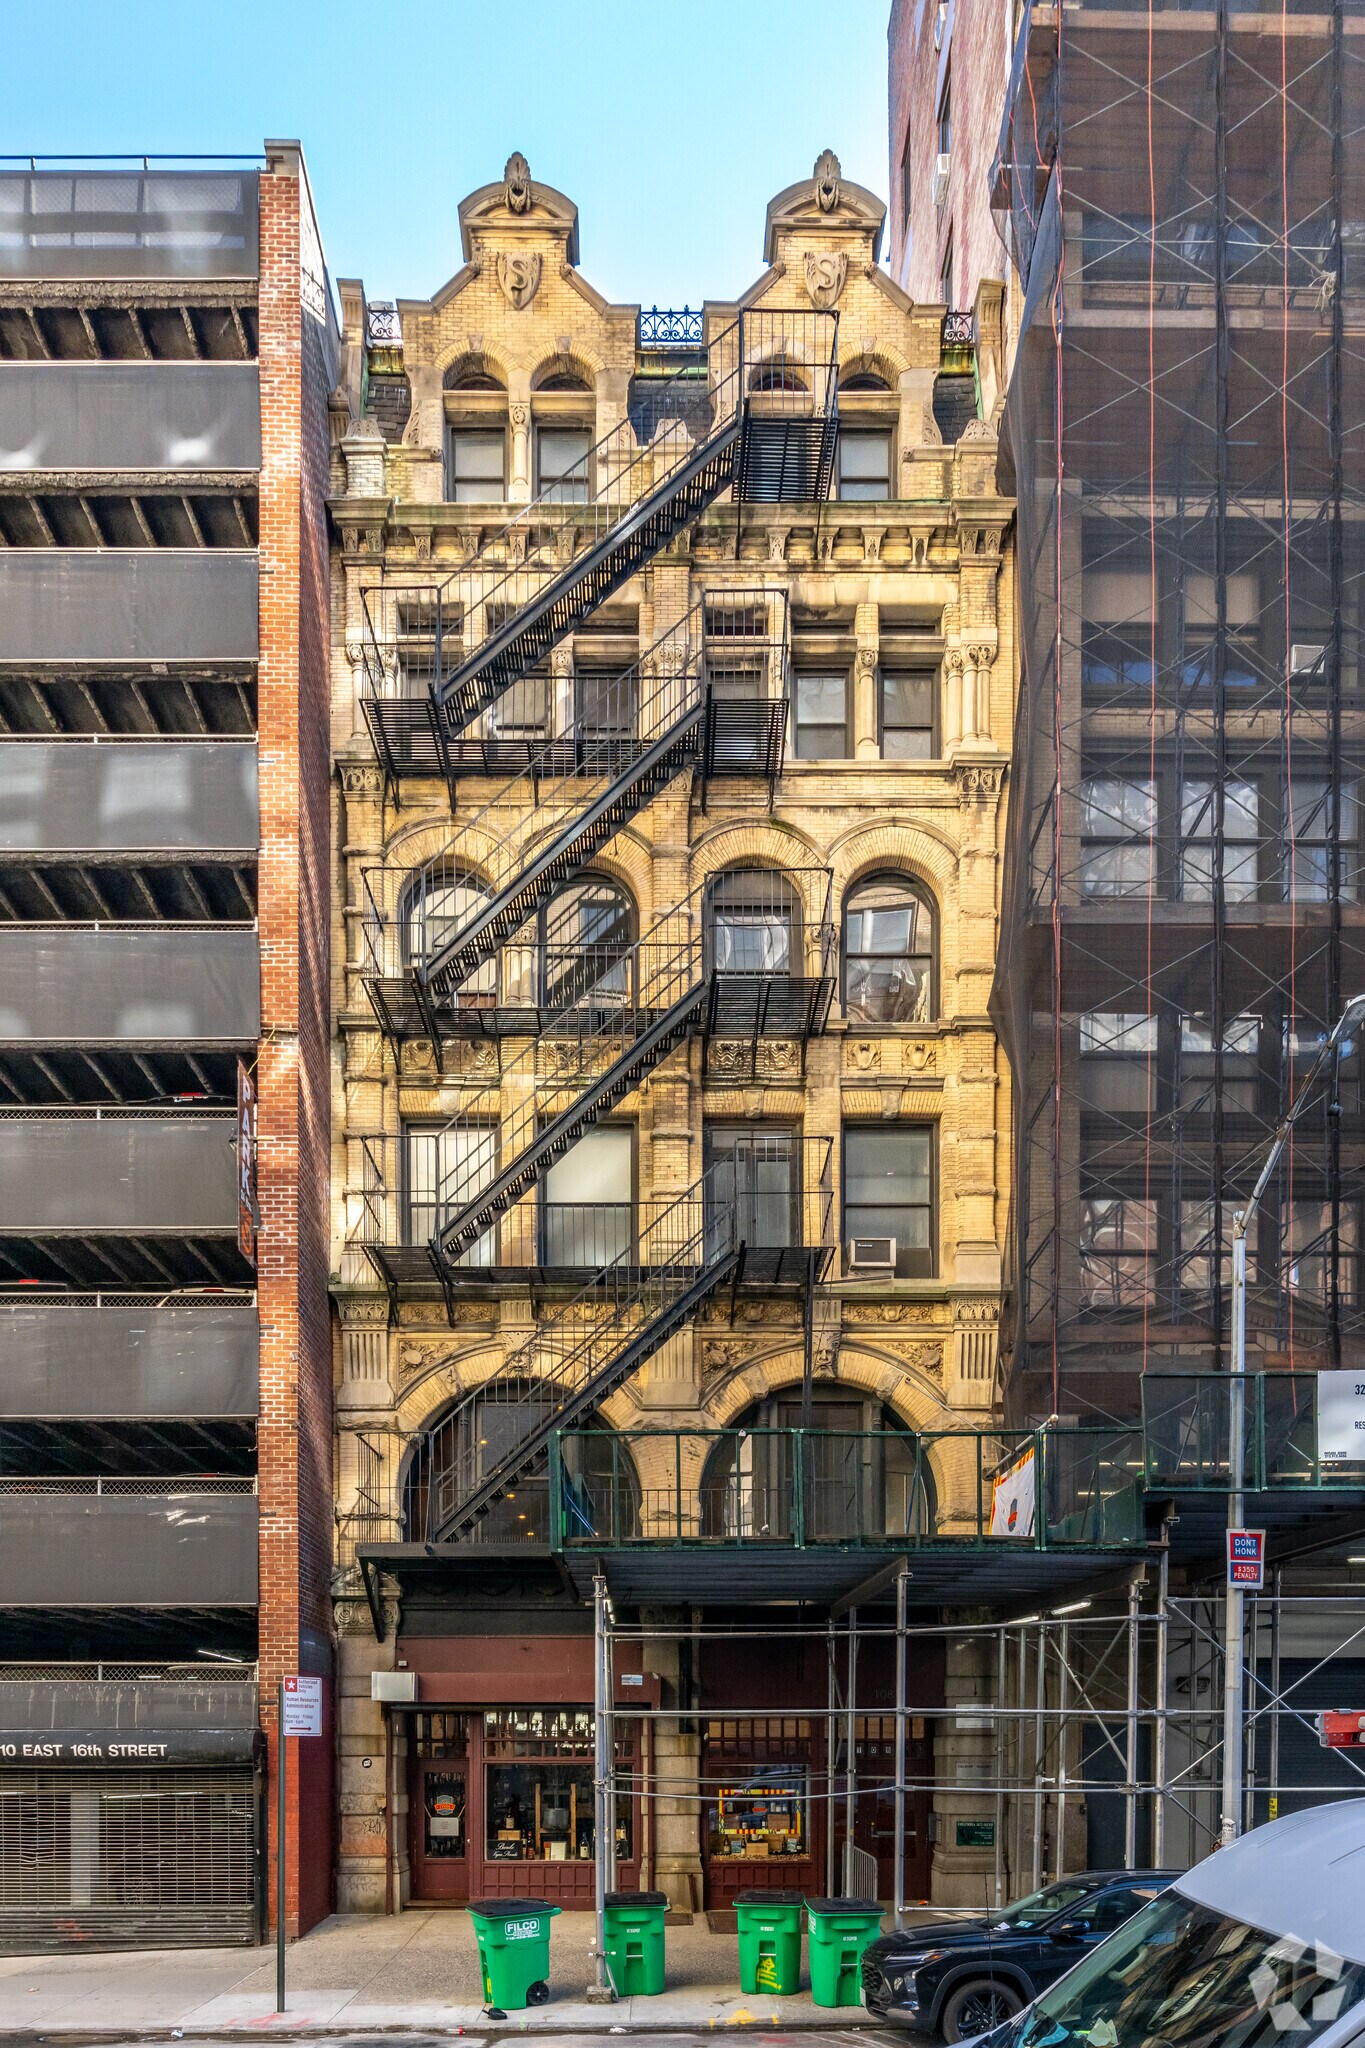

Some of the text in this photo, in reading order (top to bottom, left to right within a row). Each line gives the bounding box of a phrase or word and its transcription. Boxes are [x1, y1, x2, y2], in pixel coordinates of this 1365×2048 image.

[242, 1074, 251, 1198] PARK
[874, 1689, 894, 1700] 108
[22, 1744, 63, 1757] EAST
[70, 1744, 102, 1757] 16th
[108, 1744, 168, 1757] STREET
[507, 1920, 537, 1933] FILCO
